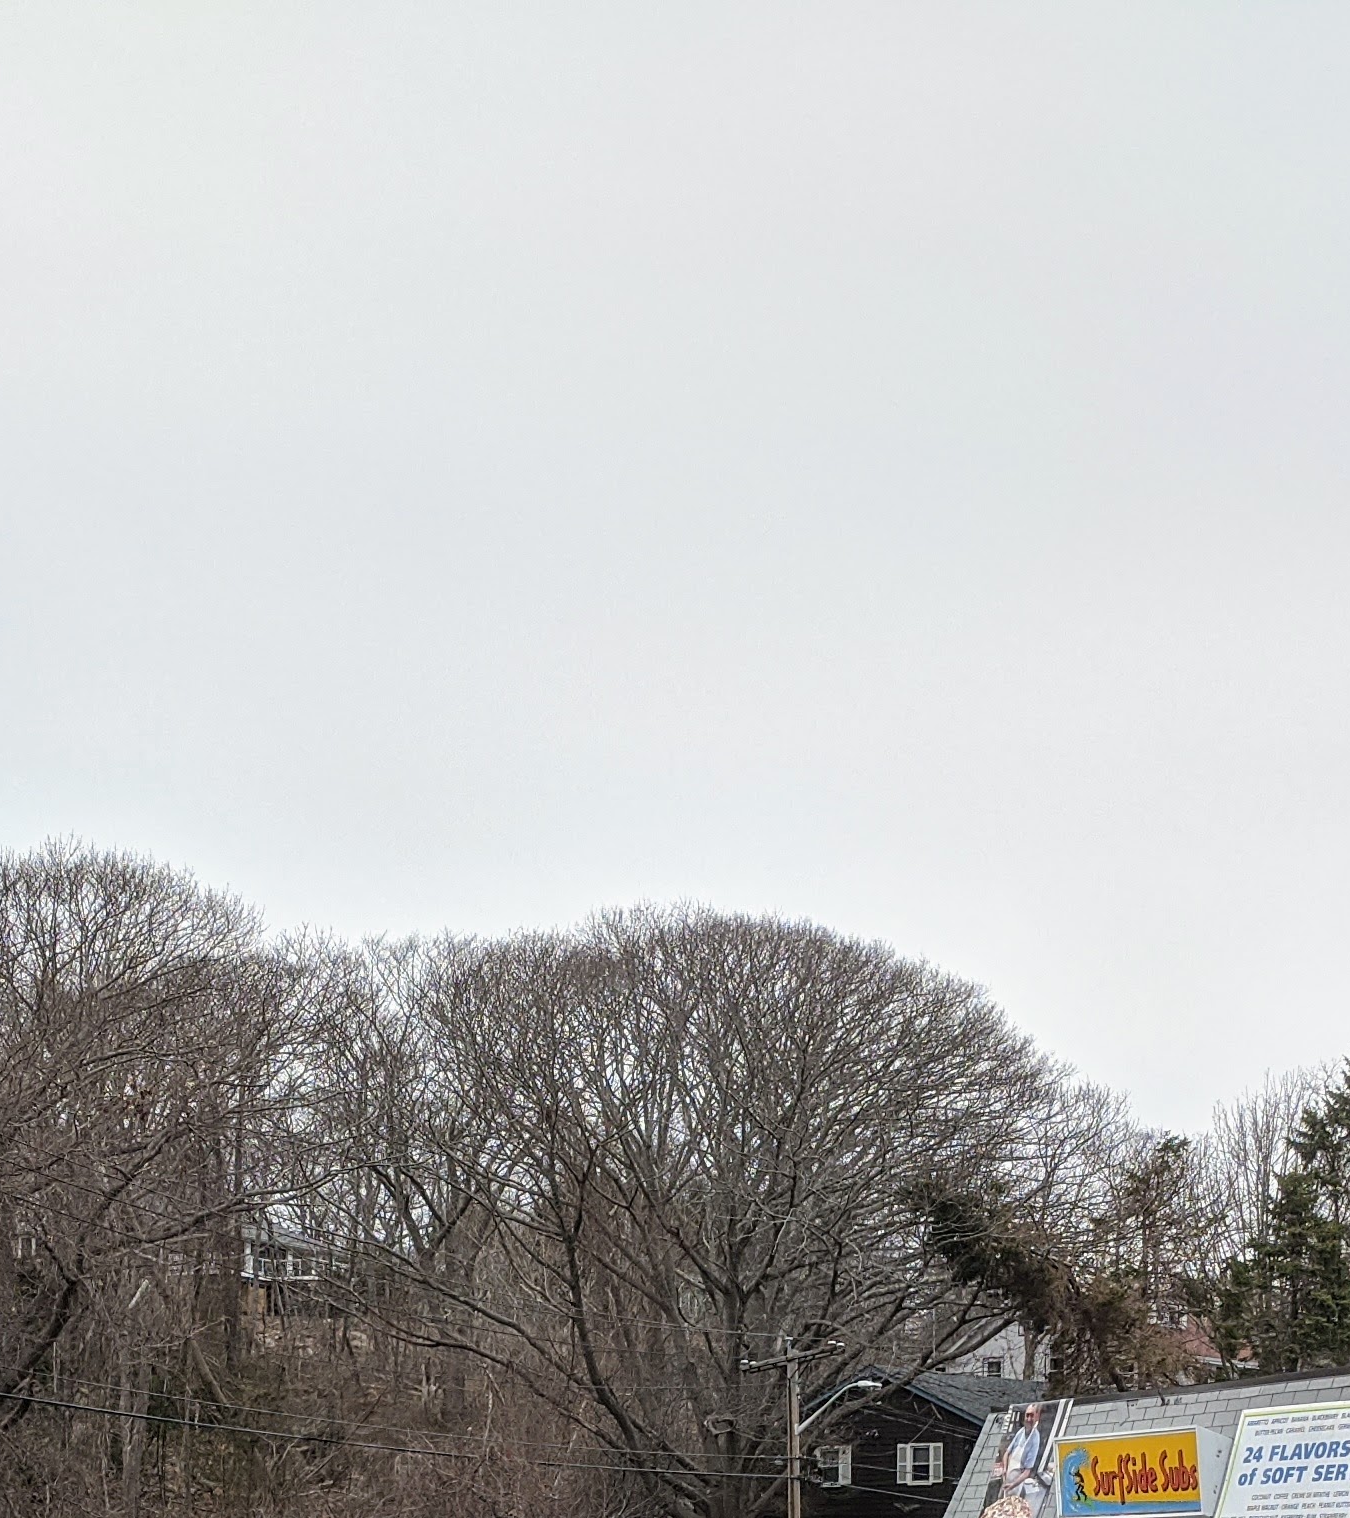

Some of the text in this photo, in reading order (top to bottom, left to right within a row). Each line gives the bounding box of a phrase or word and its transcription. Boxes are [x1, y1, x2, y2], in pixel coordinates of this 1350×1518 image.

[1243, 1446, 1263, 1464] 24
[1159, 1449, 1198, 1492] Subs
[1237, 1467, 1258, 1486] of
[1260, 1465, 1309, 1484] SOFT
